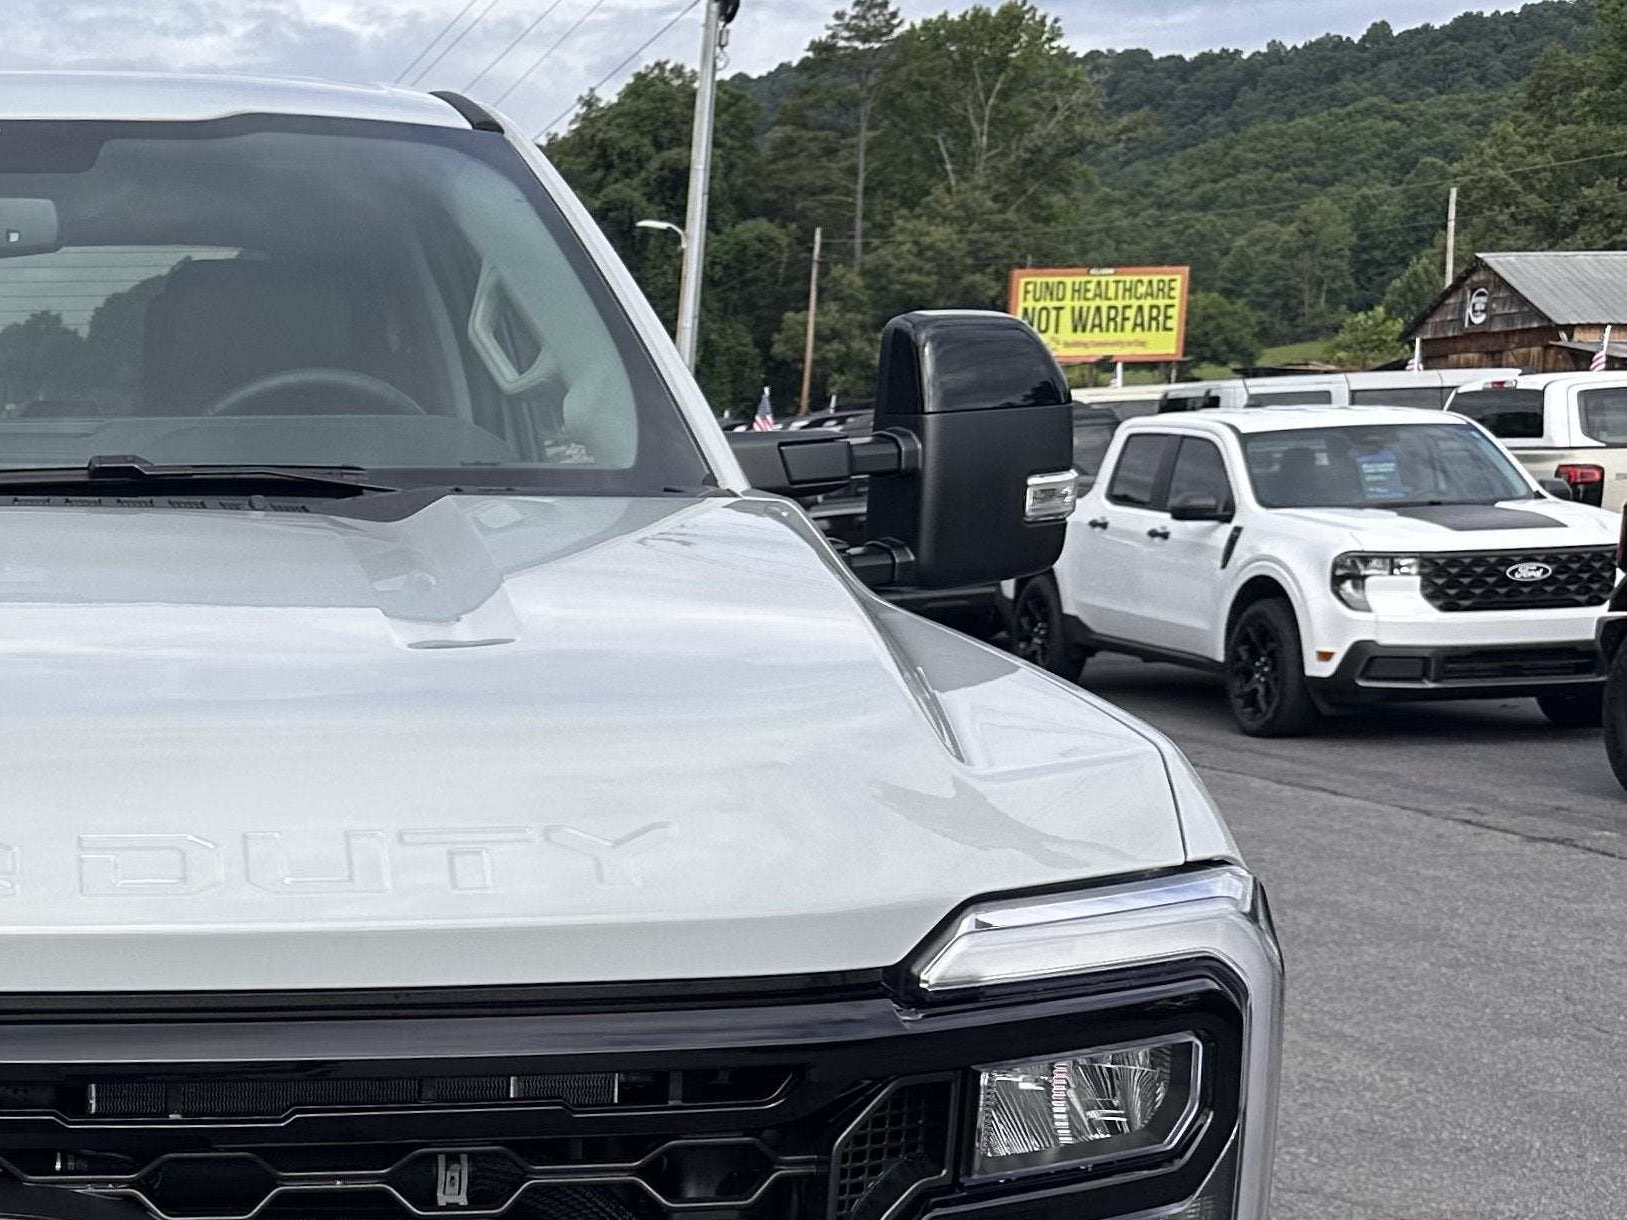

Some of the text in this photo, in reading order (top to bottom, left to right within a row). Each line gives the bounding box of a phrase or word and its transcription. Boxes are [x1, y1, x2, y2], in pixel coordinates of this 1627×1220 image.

[1023, 278, 1177, 302] FUND HEALTHCARE
[1022, 304, 1175, 334] NOT WARFARE
[75, 822, 681, 898] DUTY
